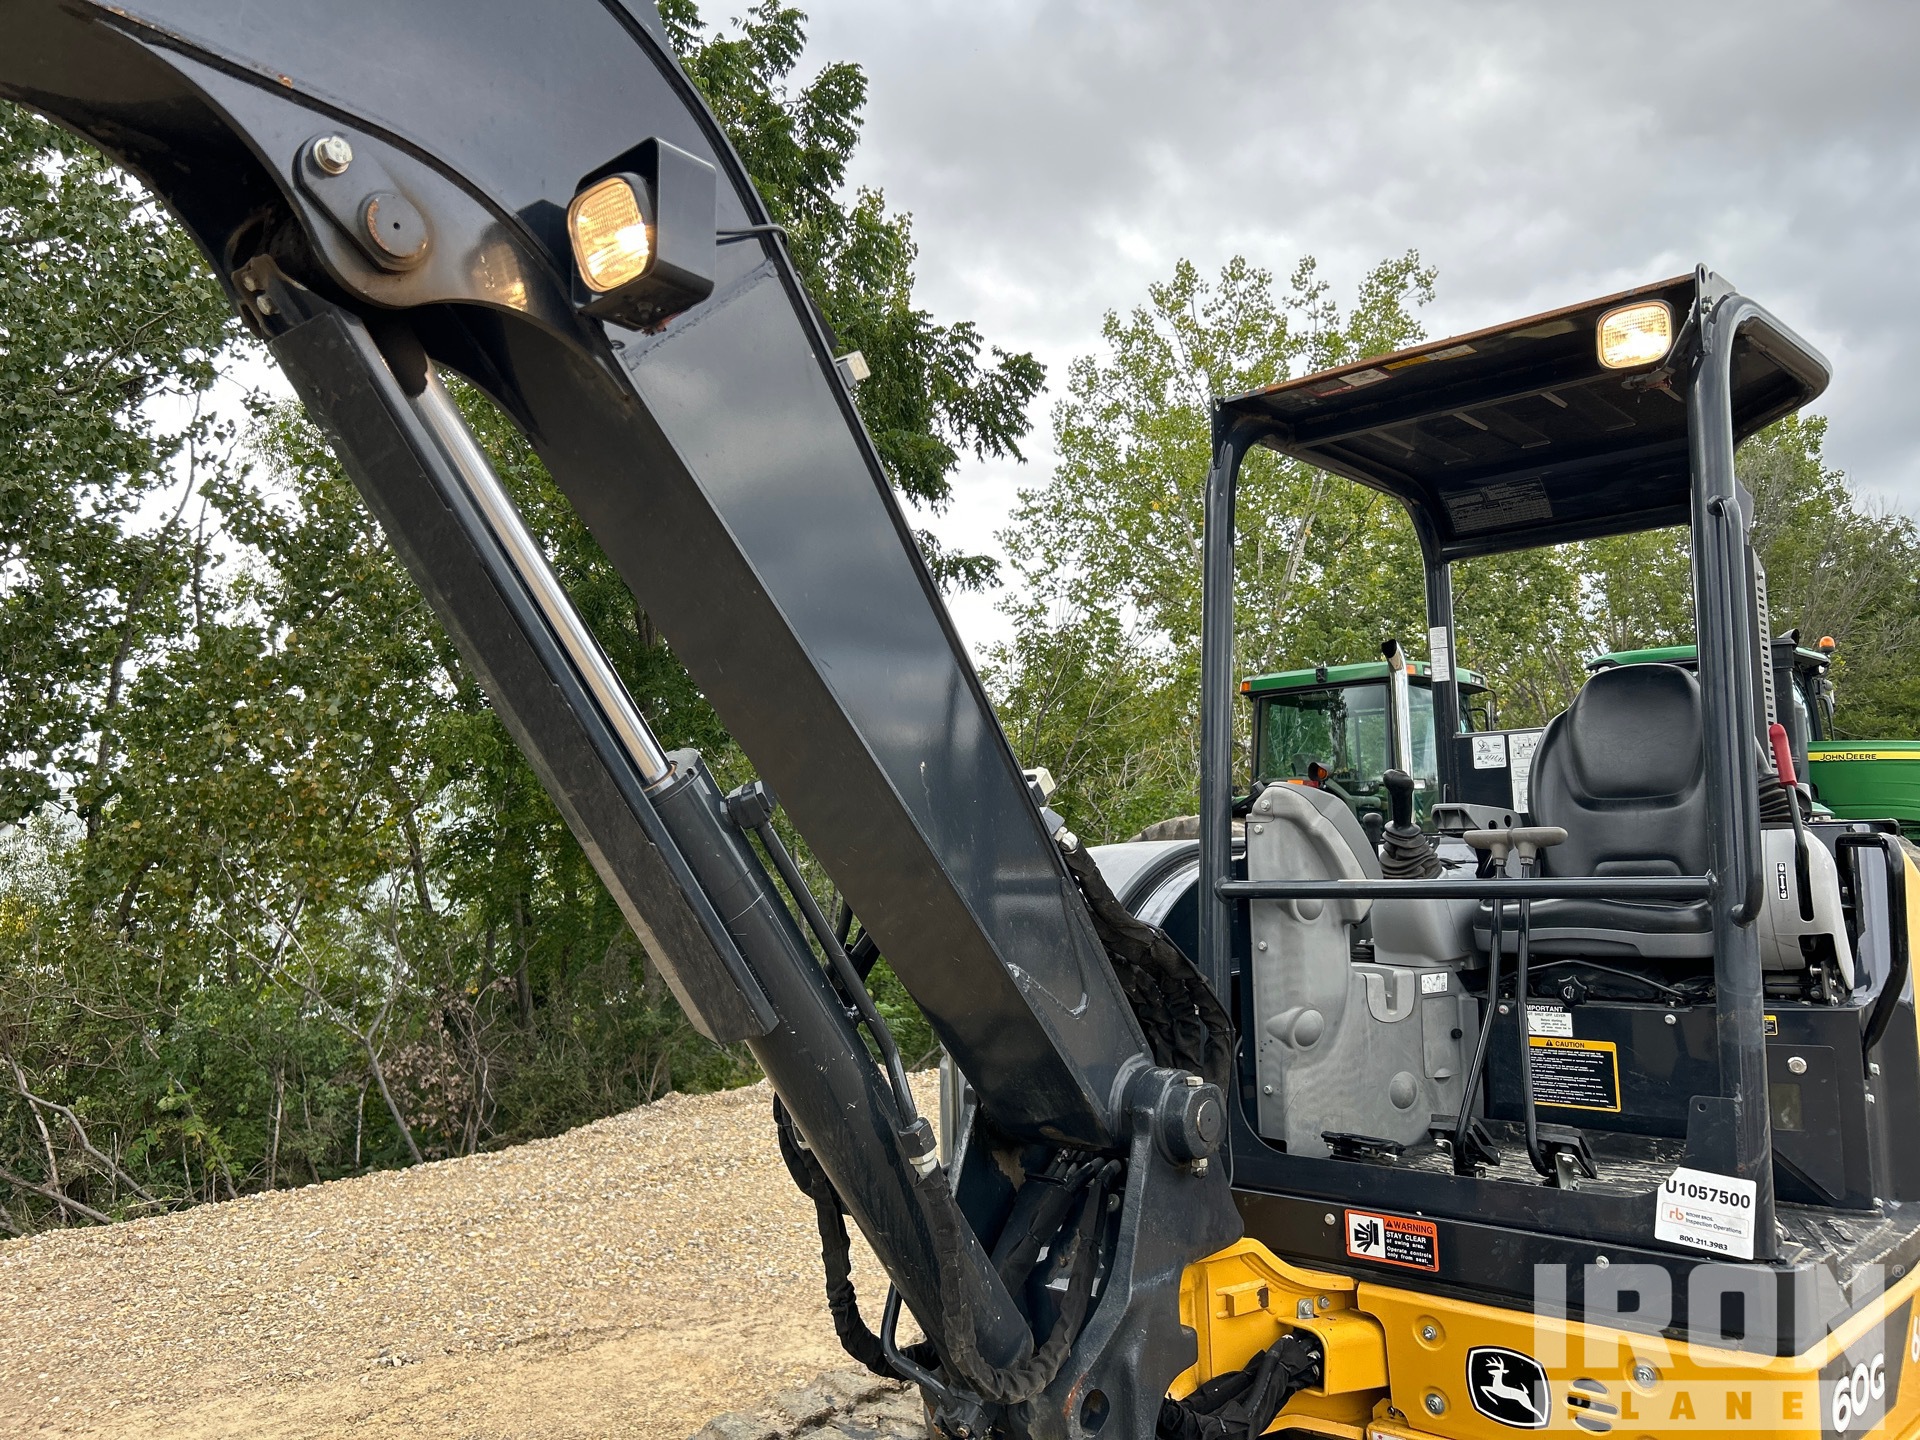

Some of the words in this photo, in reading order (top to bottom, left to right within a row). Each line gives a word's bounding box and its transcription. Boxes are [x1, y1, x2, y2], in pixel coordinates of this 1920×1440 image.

[1665, 1180, 1751, 1209] U1057500
[1394, 1221, 1433, 1234] WARNING
[1686, 1217, 1712, 1228] Inspection
[1713, 1223, 1742, 1235] Operations
[1386, 1231, 1402, 1239] STAY
[1404, 1234, 1427, 1244] CLEAR
[1679, 1234, 1728, 1251] 800.211.3983
[1386, 1245, 1408, 1254] Operate
[1832, 1353, 1885, 1433] 60G
